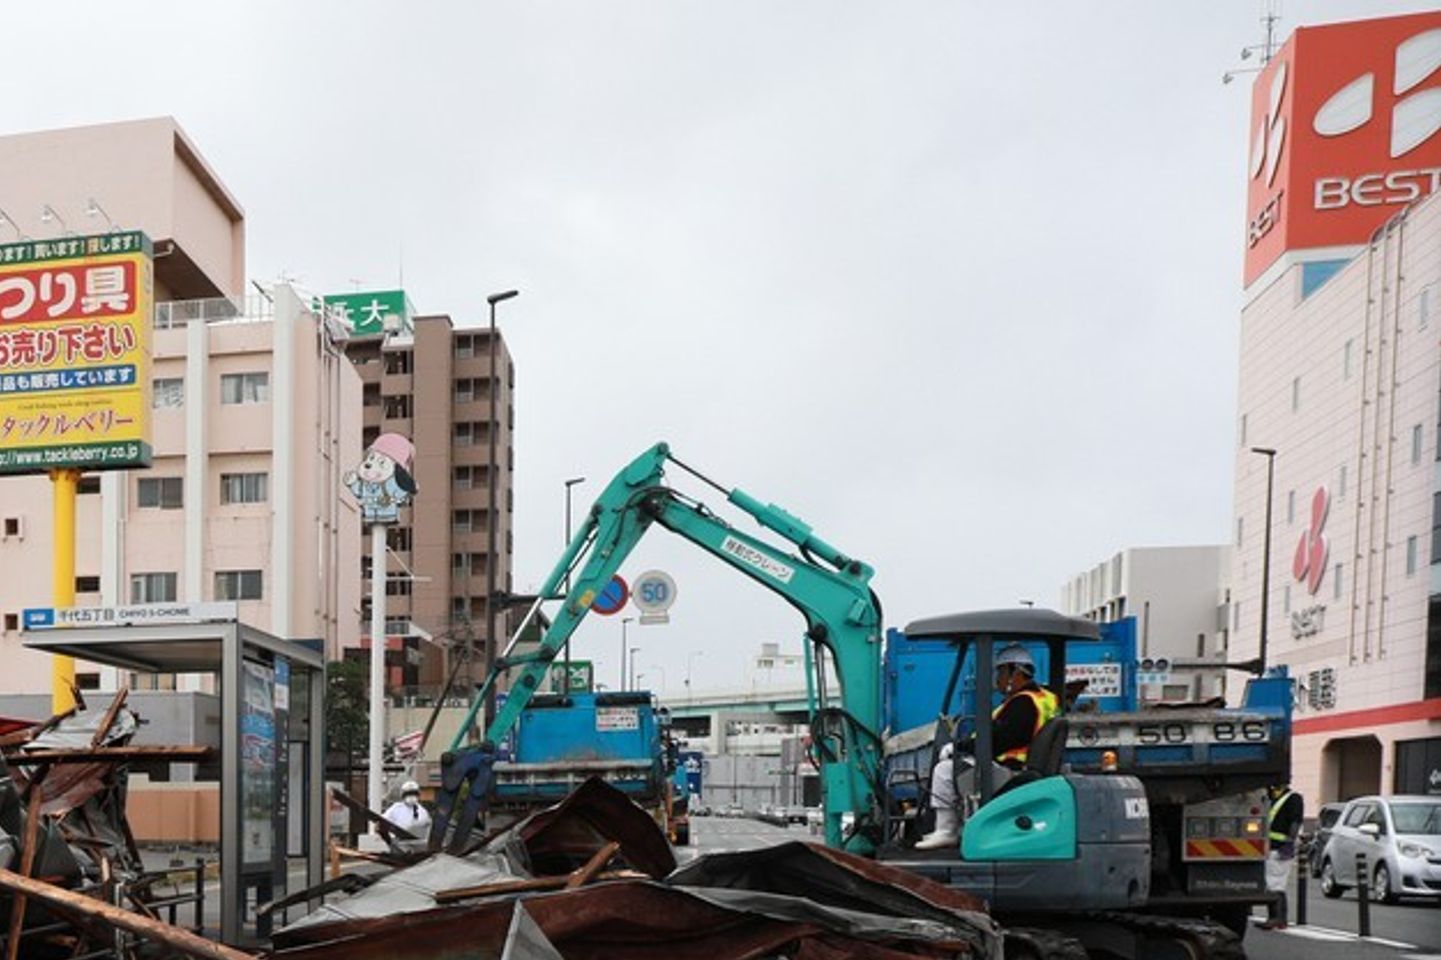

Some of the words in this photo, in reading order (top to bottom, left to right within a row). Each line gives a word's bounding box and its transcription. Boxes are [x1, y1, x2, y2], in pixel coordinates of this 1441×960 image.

[1314, 167, 1441, 210] BEST
[1, 409, 134, 438] タックルベリー
[641, 582, 667, 600] 50
[1213, 721, 1266, 742] 86
